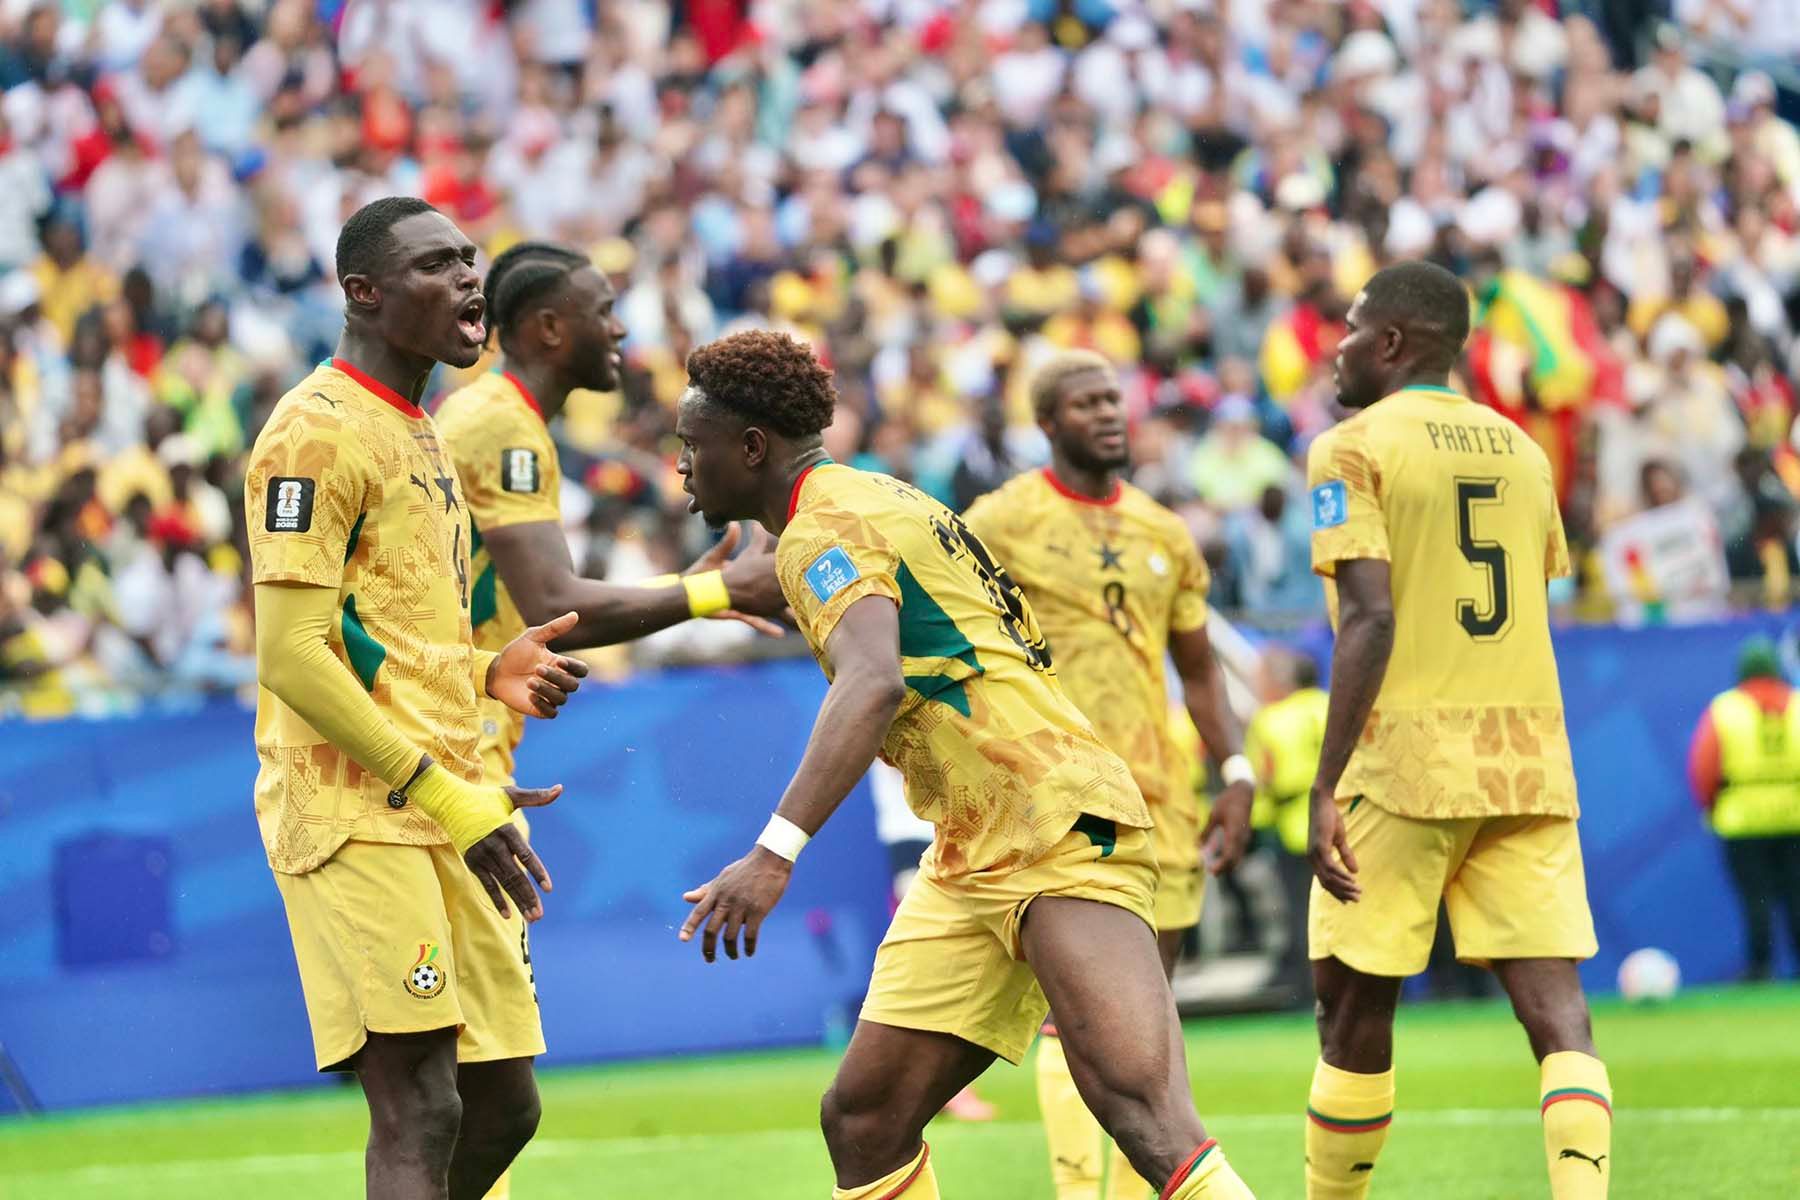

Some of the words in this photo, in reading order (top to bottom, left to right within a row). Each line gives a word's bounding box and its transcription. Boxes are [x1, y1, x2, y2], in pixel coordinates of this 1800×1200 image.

[1426, 421, 1515, 454] PARTEY
[1454, 476, 1515, 643] 5
[1103, 581, 1130, 636] 8
